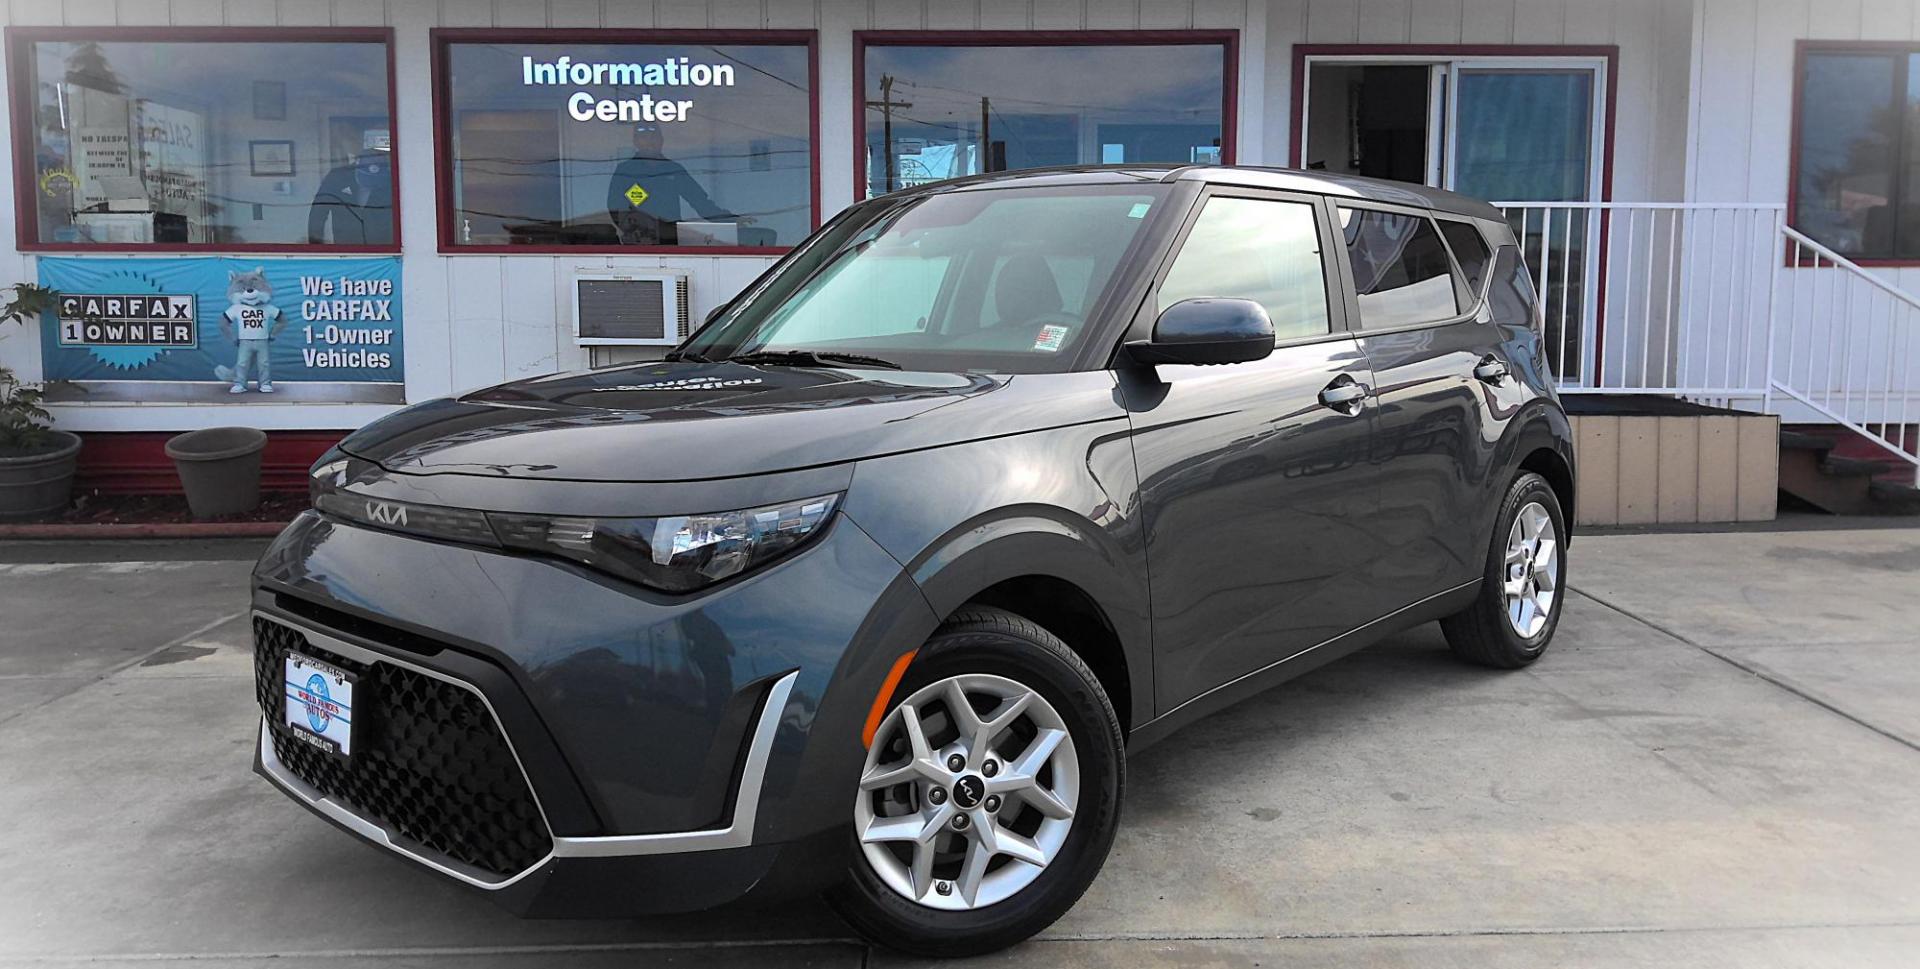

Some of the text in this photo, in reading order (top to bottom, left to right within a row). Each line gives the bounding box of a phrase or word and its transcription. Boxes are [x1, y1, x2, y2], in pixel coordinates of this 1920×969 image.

[522, 56, 735, 86] Information
[567, 91, 693, 122] Center
[301, 276, 392, 296] We have
[63, 299, 188, 319] CARFAX
[241, 309, 264, 319] CAR
[302, 299, 392, 321] CARFAX
[243, 320, 264, 329] FOX
[302, 325, 393, 345] 1-Owner
[302, 348, 391, 369] Vehicles
[366, 501, 408, 528] KIA
[298, 690, 340, 715] WORLD FAMOUS
[307, 703, 331, 721] AUTOS
